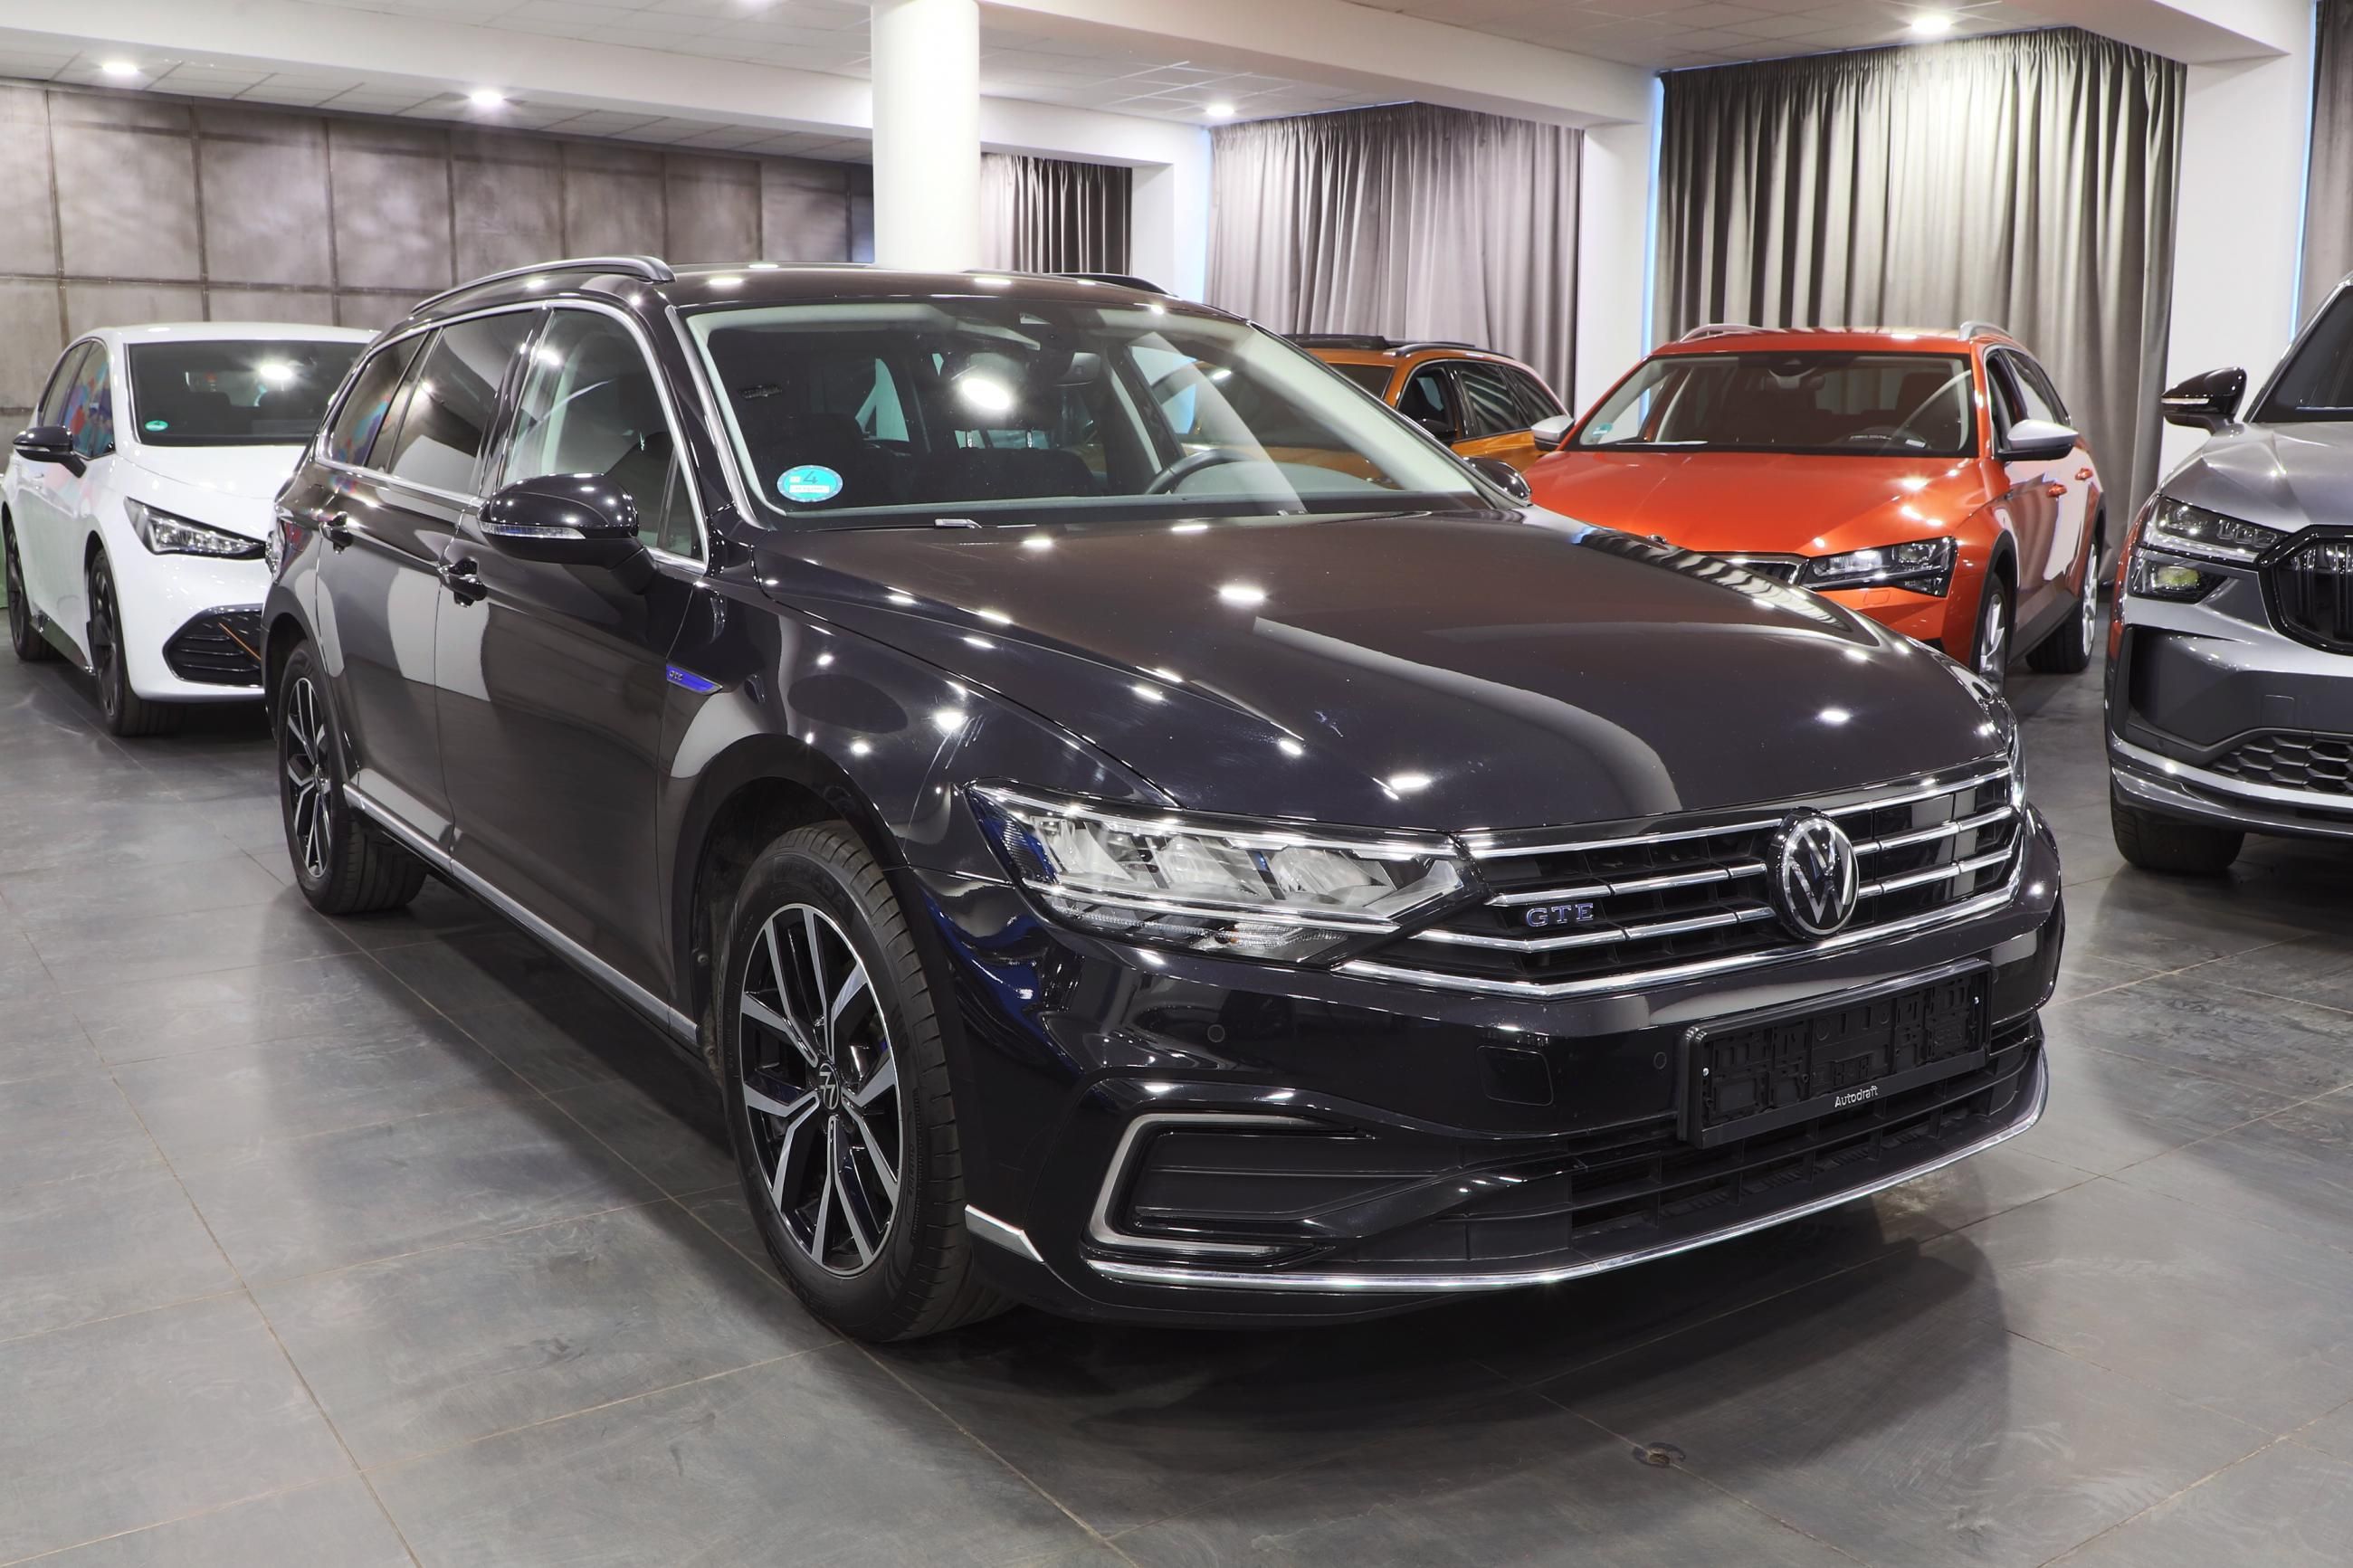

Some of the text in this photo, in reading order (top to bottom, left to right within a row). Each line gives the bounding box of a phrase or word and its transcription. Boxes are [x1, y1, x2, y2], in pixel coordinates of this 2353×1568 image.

[803, 470, 818, 485] 4
[1526, 902, 1594, 927] GTE
[1834, 1085, 1879, 1108] Autodraft
